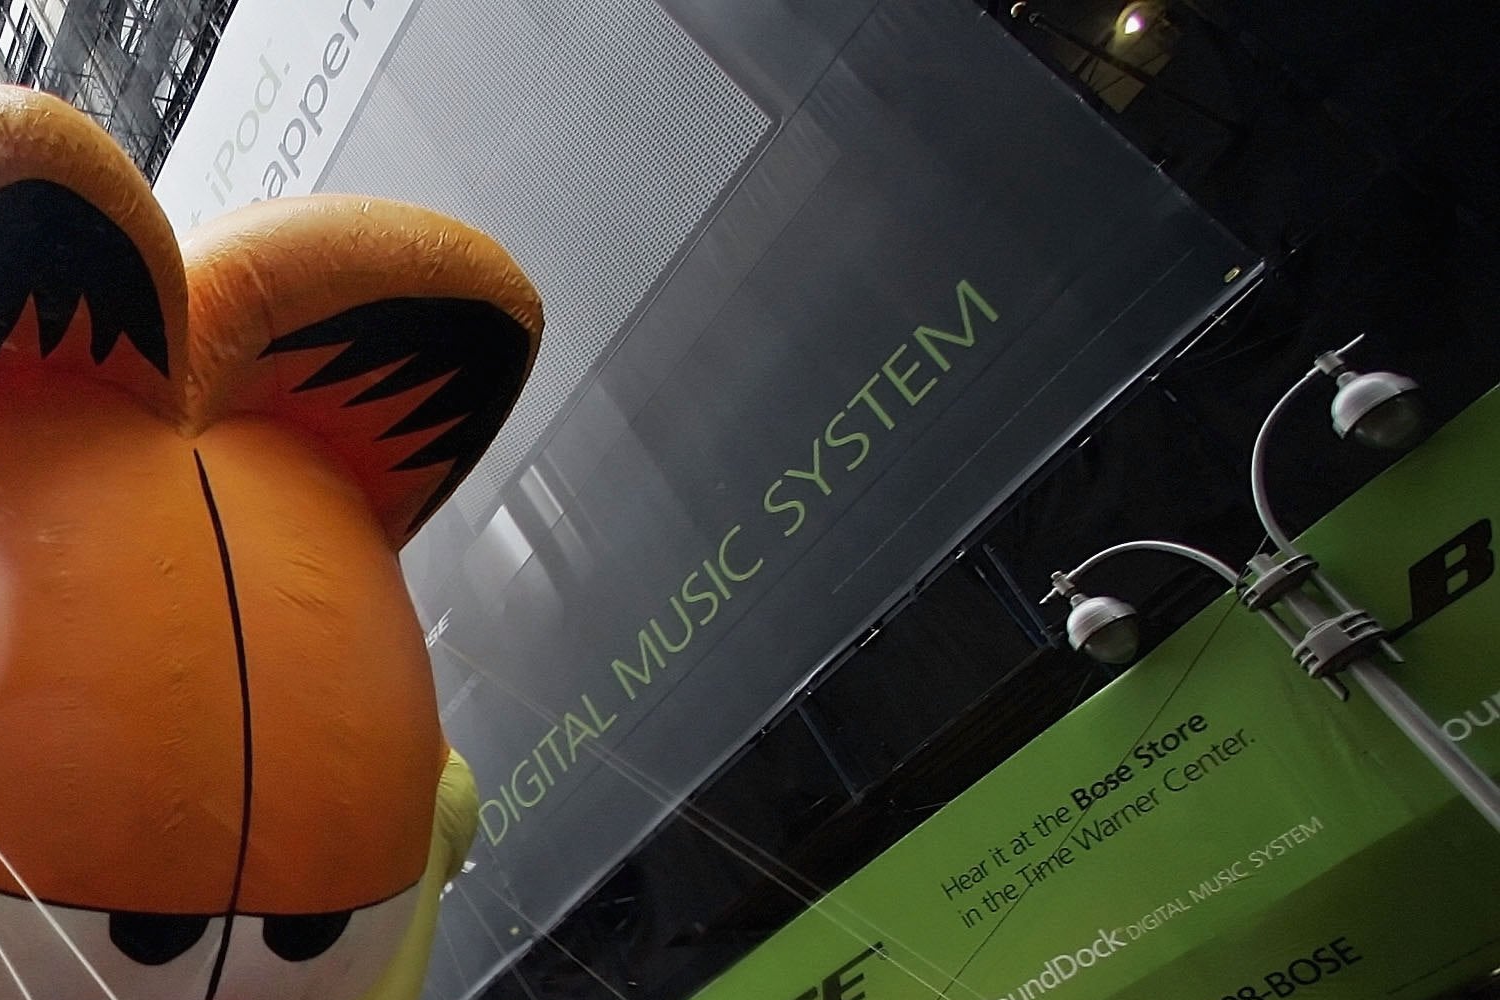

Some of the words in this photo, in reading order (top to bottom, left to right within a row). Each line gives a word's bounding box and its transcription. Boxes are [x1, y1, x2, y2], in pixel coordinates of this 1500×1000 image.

[476, 694, 618, 847] DIGITAL
[610, 524, 764, 701] MUSIC
[763, 279, 999, 537] SYSTEM
[940, 859, 989, 901] Hear
[991, 846, 1011, 868] it
[1011, 831, 1035, 857] at
[1033, 805, 1073, 838] the
[1070, 764, 1134, 811] Bose
[1133, 713, 1209, 769] Store
[958, 906, 984, 929] in
[981, 881, 1019, 914] the
[1015, 846, 1076, 888] Time
[1071, 786, 1161, 851] Warner
[1162, 728, 1256, 793] Center.
[1125, 898, 1192, 942] DIGITAL
[1188, 860, 1249, 903] MUSIC
[1248, 815, 1325, 869] SYSTEM
